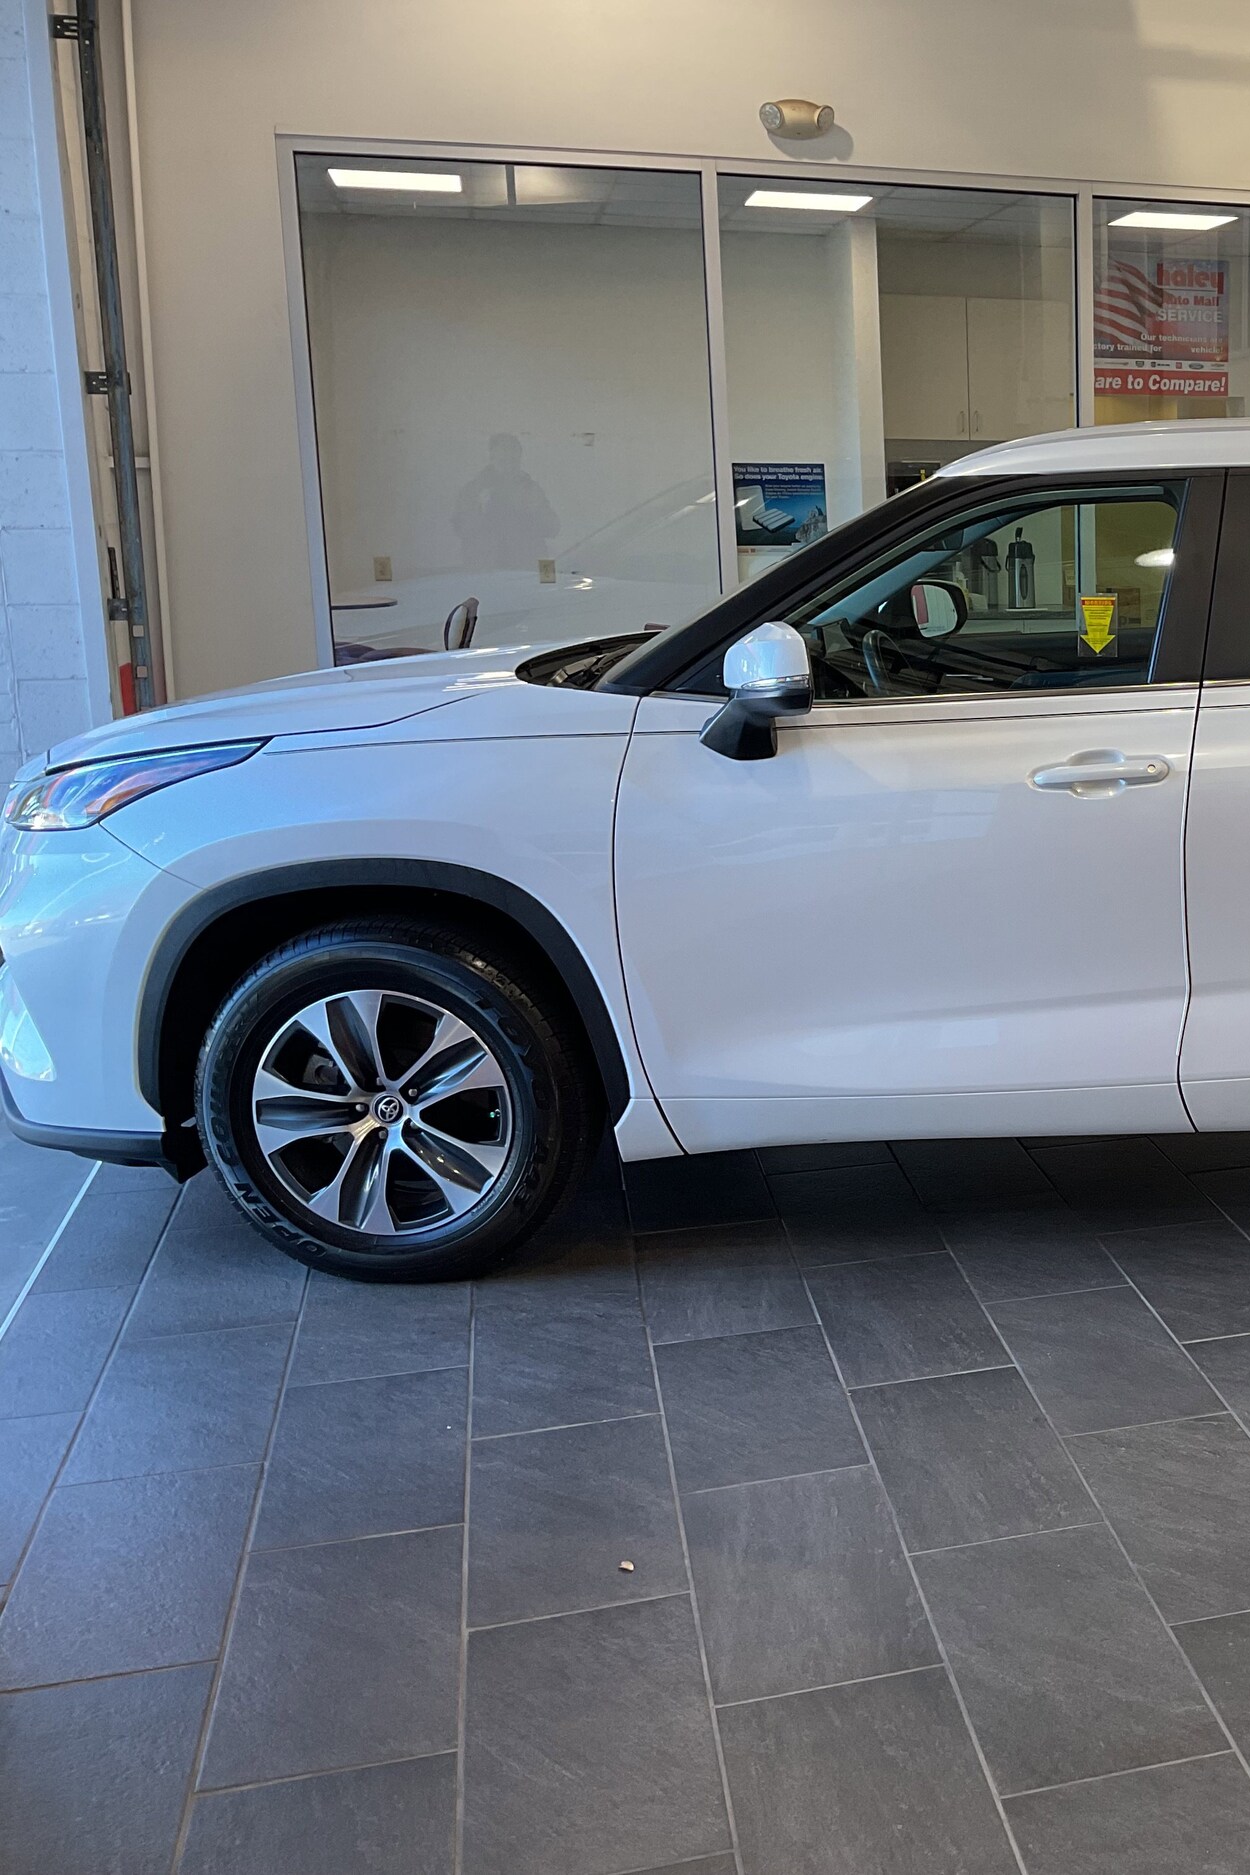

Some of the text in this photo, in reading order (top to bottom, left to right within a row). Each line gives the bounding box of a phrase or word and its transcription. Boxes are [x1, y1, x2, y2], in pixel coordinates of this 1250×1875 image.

[1193, 296, 1219, 306] Mall
[1157, 309, 1223, 323] SERVICE
[1140, 333, 1156, 341] Our
[1158, 334, 1207, 344] technicians
[1117, 343, 1148, 352] trained
[1150, 343, 1163, 354] for
[1094, 374, 1226, 394] are to Compare!
[777, 473, 800, 481] Toyota
[475, 988, 551, 1112] TOYO
[234, 1181, 328, 1259] OPEN
